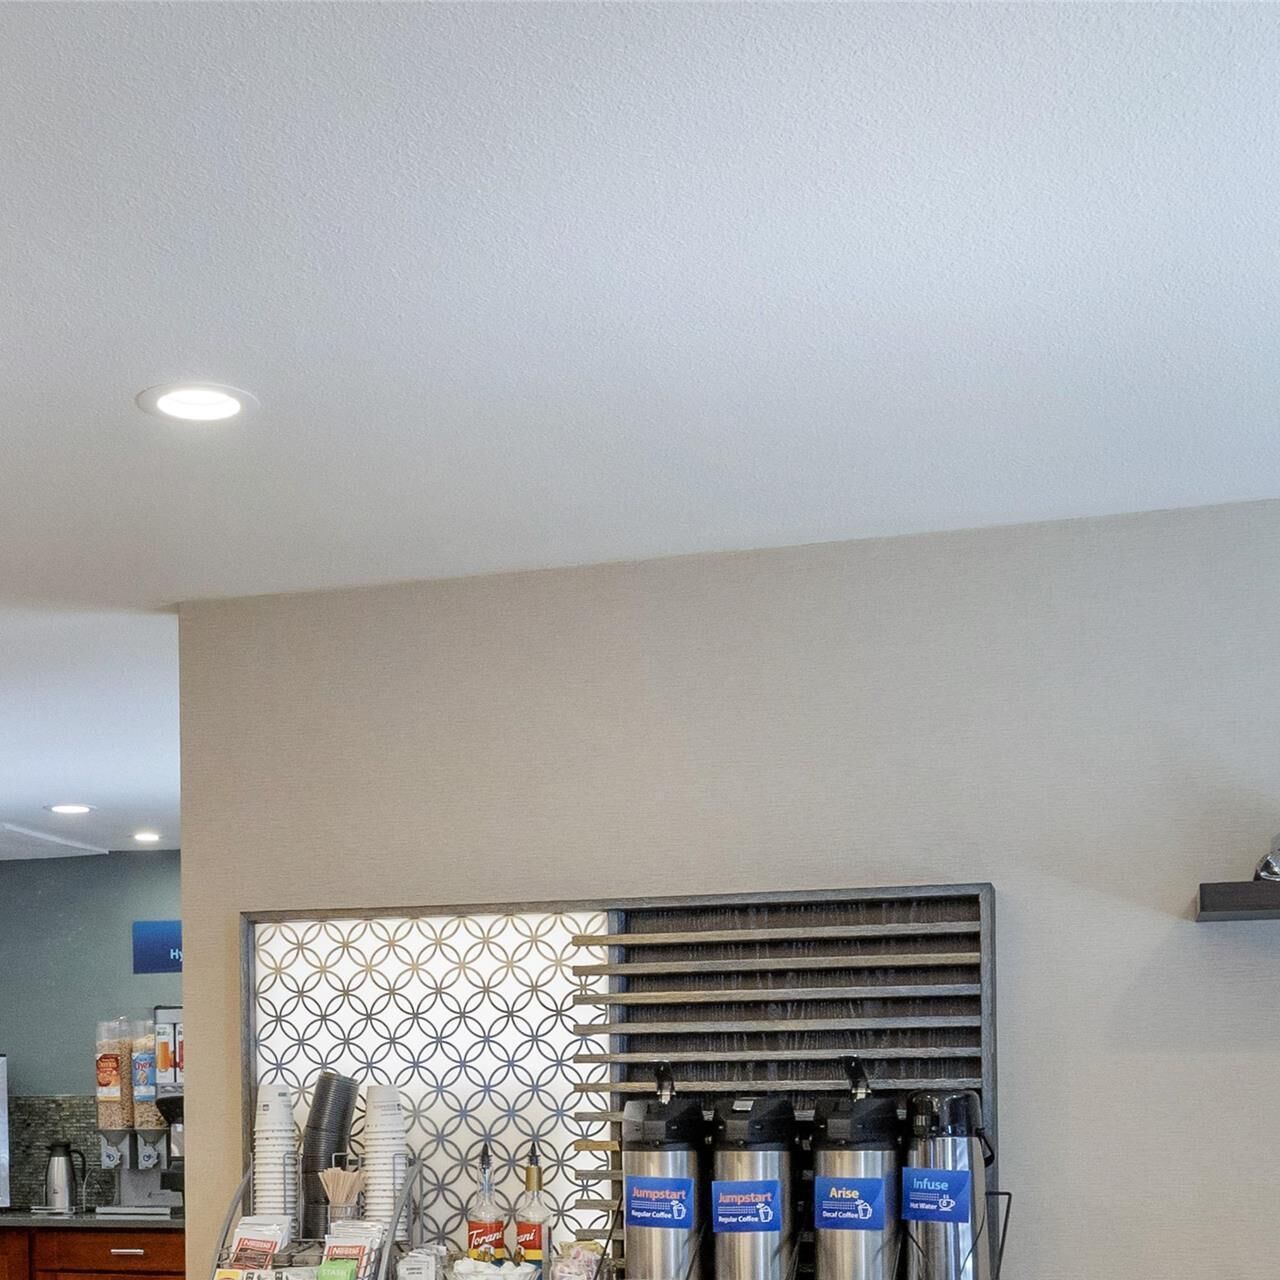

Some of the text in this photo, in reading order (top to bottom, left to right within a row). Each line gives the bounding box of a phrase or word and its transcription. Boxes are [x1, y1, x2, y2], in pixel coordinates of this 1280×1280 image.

[913, 1178, 949, 1190] Infuse
[632, 1187, 687, 1200] Jumpstart
[719, 1192, 773, 1204] Jumpstart
[829, 1187, 860, 1199] Arise
[919, 1202, 938, 1210] Water
[631, 1209, 672, 1219] Regular Coffee
[718, 1215, 759, 1223] Regular Coffee
[822, 1210, 859, 1219] Decaf Coffee
[469, 1230, 503, 1249] Torani
